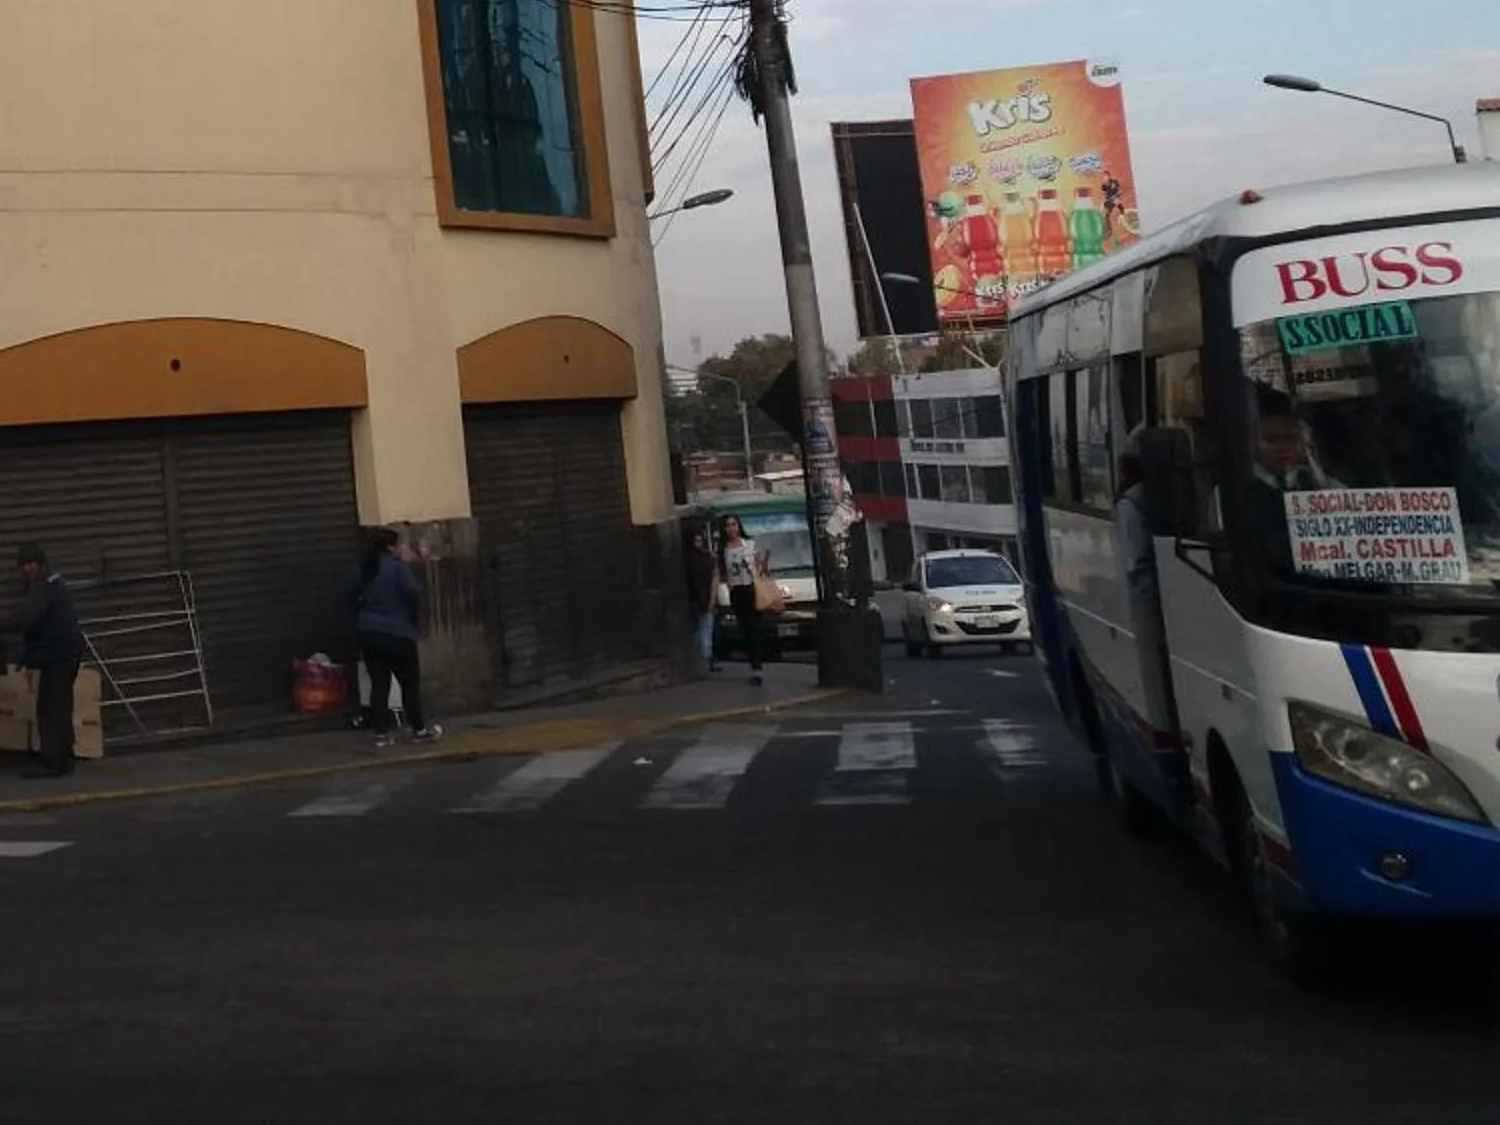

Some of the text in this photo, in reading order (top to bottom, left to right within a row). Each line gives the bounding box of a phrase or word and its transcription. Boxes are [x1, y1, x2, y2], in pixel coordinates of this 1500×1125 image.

[968, 89, 1052, 136] Kris
[1274, 242, 1463, 305] BUSS
[1399, 490, 1451, 512] BOSCO
[1296, 517, 1332, 538] SIGLO
[1299, 537, 1458, 562] Mcal. CASTILLA
